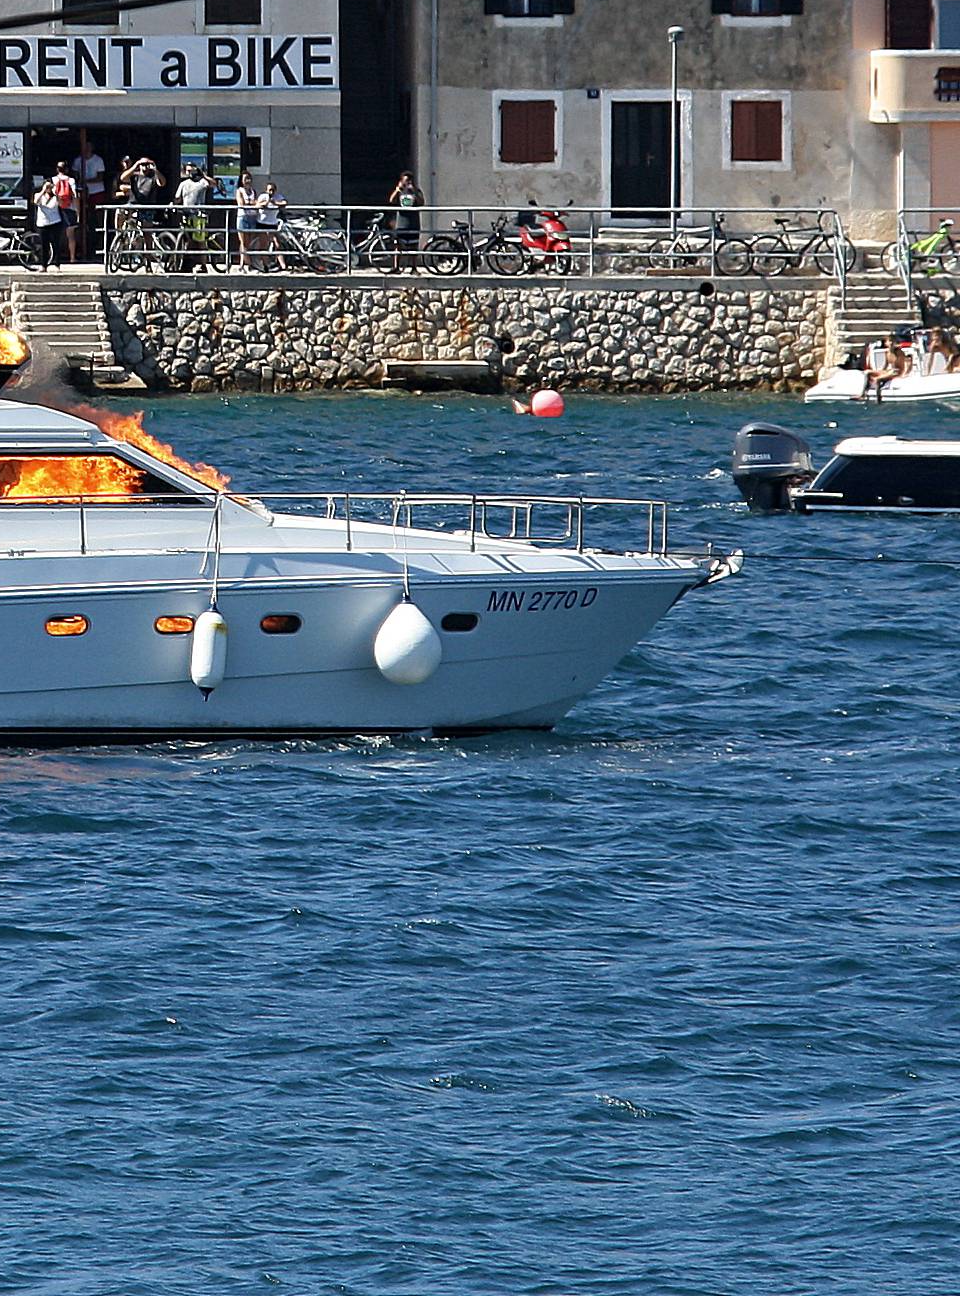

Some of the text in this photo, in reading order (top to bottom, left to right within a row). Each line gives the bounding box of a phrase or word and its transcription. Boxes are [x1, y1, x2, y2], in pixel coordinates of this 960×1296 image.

[160, 50, 188, 88] a
[208, 37, 334, 86] BIKE
[486, 588, 597, 611] MN 2770 D
